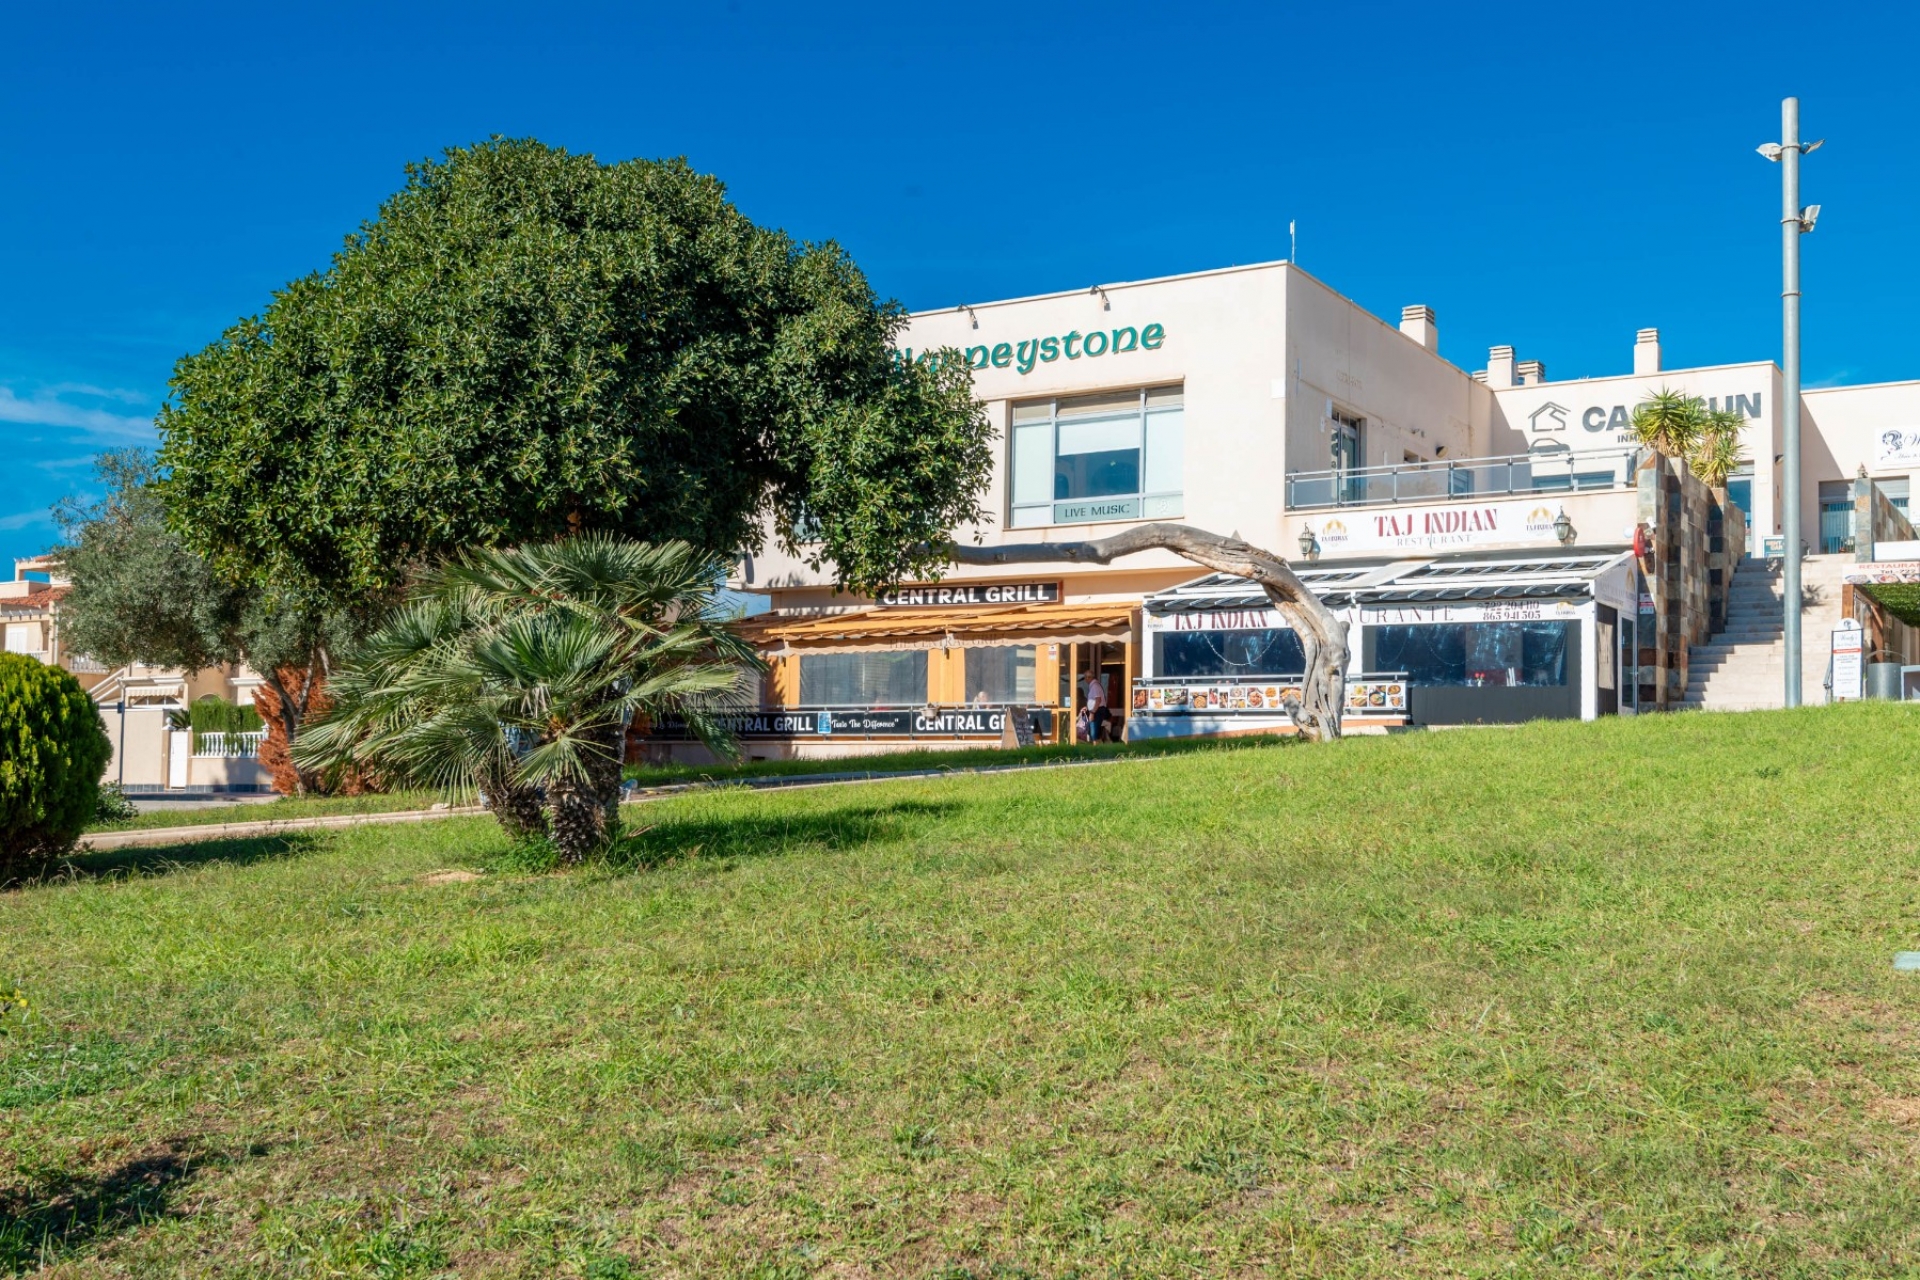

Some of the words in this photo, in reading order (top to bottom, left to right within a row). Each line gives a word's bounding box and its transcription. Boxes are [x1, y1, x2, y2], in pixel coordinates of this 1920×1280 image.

[890, 322, 1166, 375] neystone
[1582, 392, 1762, 433] CAUN
[1065, 507, 1086, 518] LIVE
[1091, 504, 1130, 516] MUSIC
[1374, 514, 1413, 537] TAJ
[1424, 509, 1498, 534] INDIAN
[883, 587, 980, 605] CENTRAL
[985, 584, 1050, 603] GRILL
[1172, 612, 1203, 631] TAJ
[1211, 610, 1269, 630] INDIAN
[1504, 611, 1520, 620] 941
[714, 717, 770, 732] NTRAL
[774, 716, 813, 732] GRILL
[849, 719, 861, 728] The
[915, 714, 985, 731] CENTRAL
